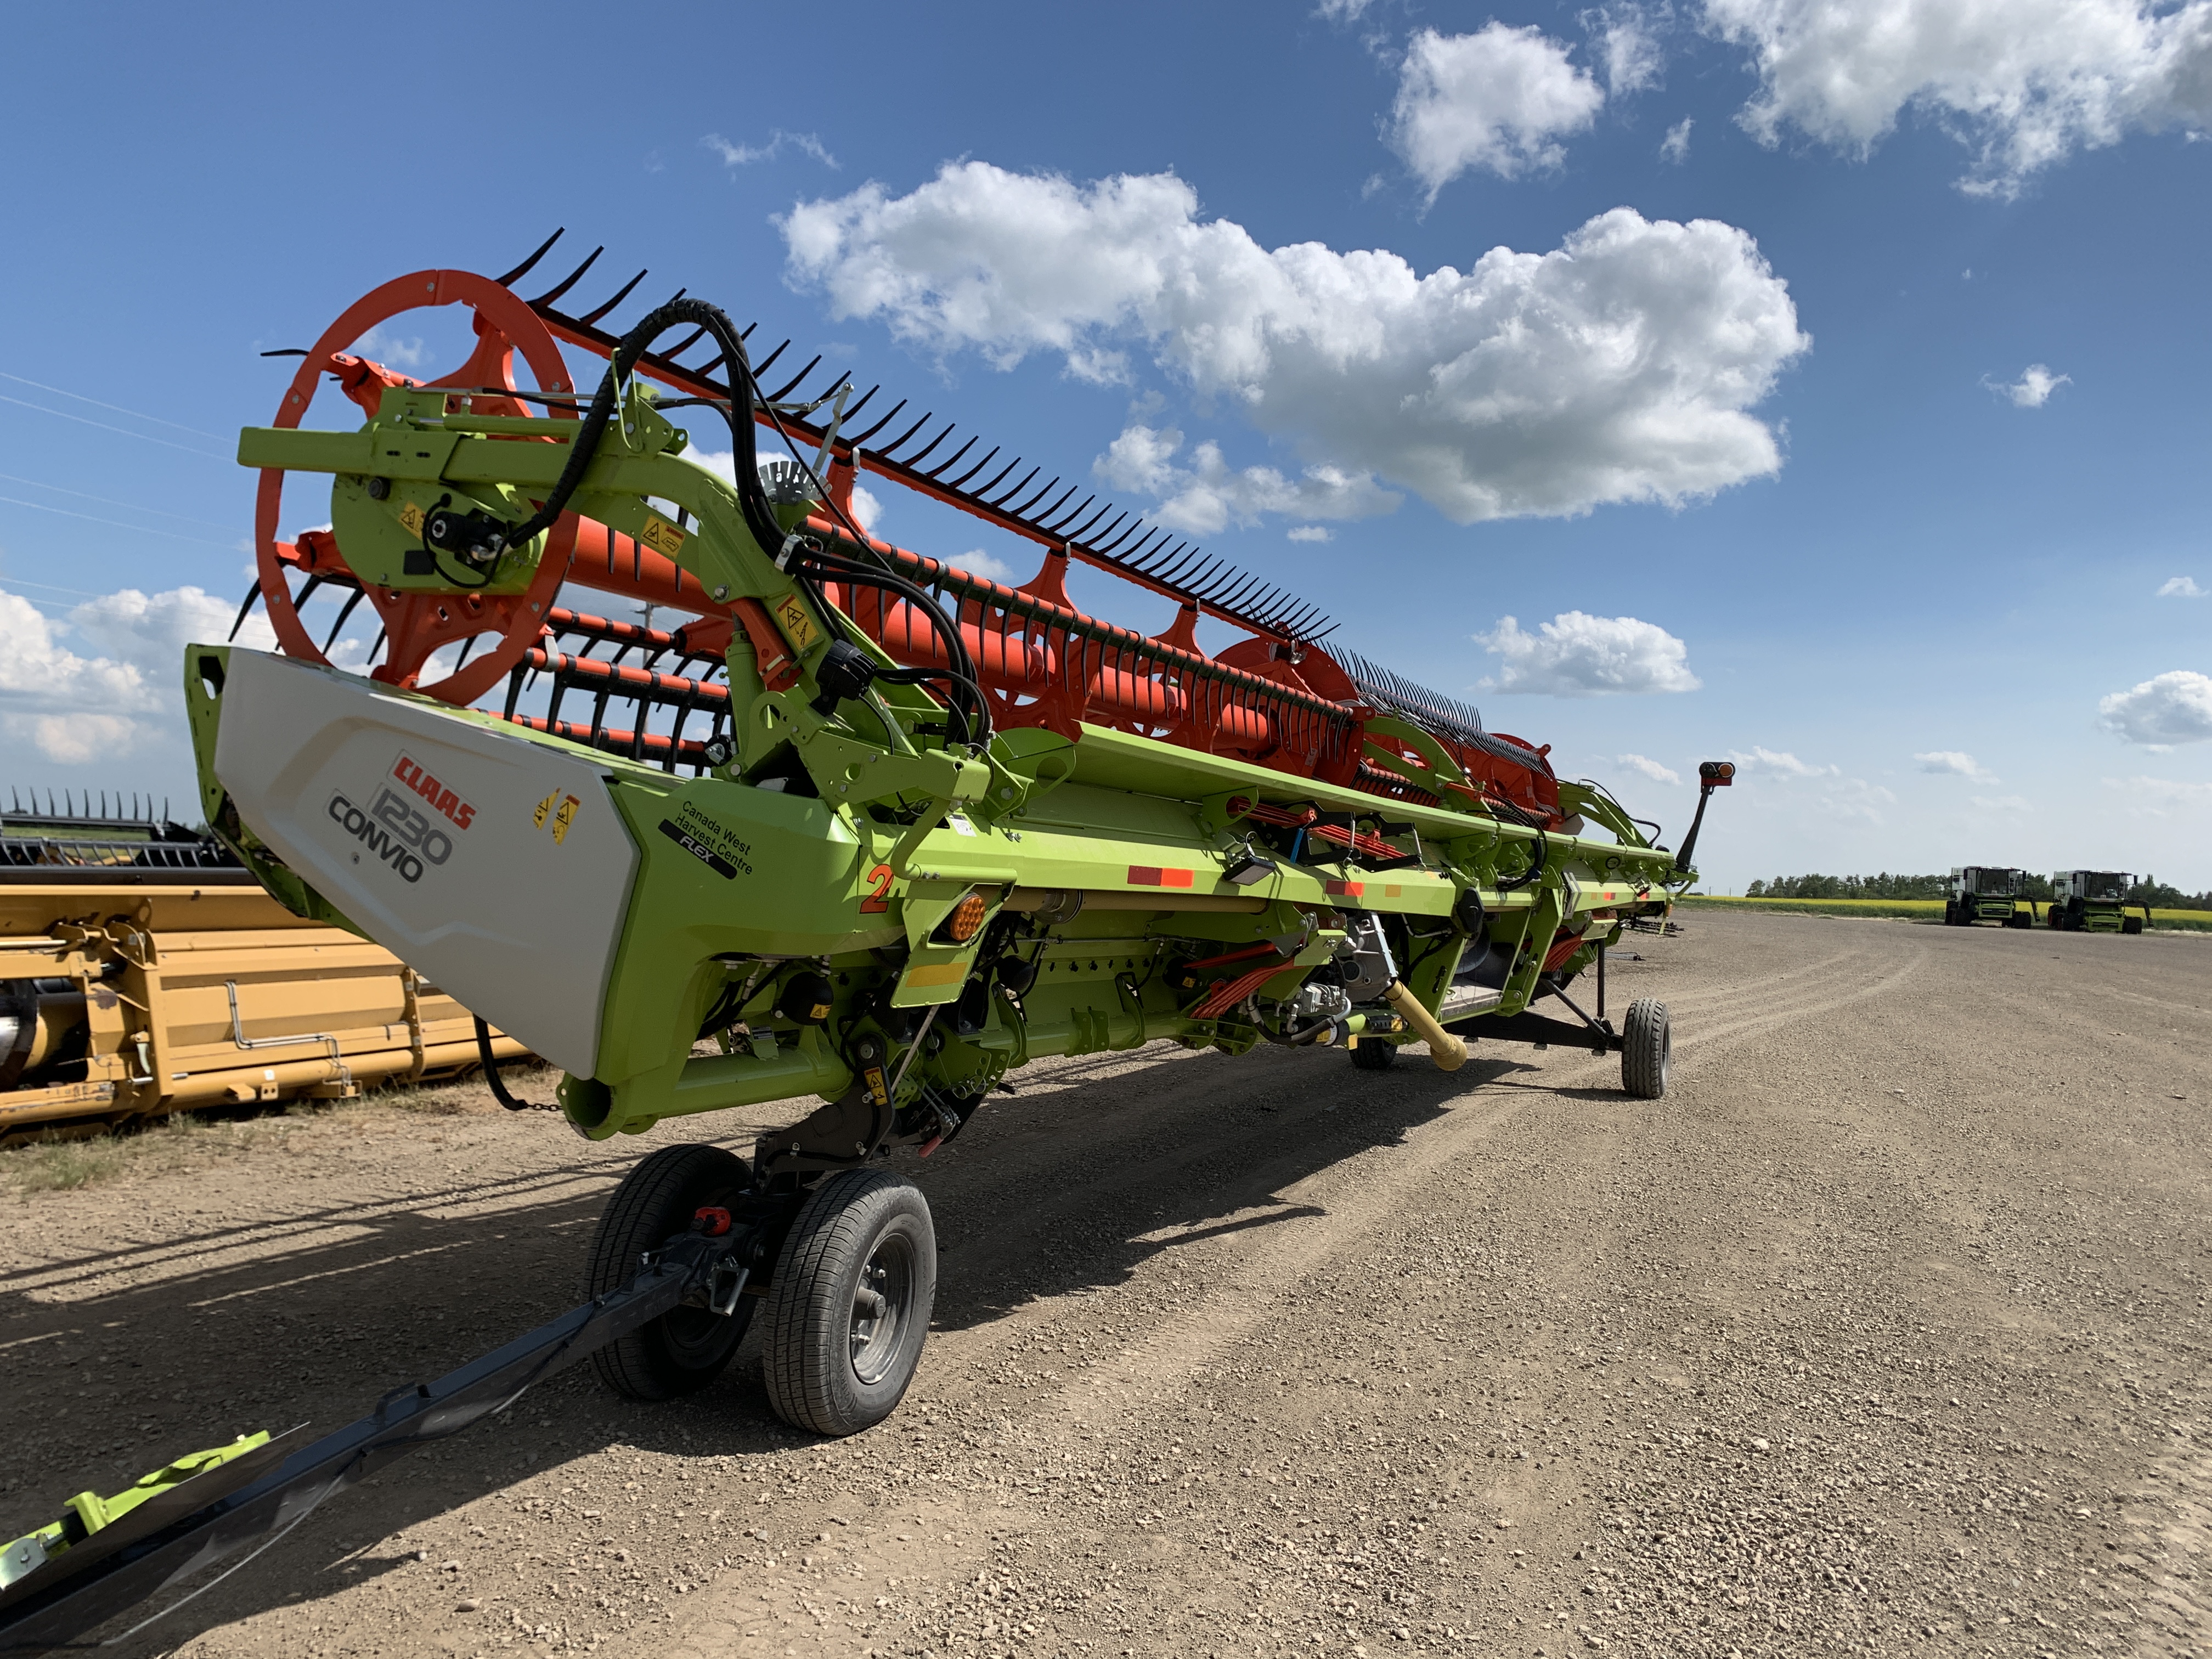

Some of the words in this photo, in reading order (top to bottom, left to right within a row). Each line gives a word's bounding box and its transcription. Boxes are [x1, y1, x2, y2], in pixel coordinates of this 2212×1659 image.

[393, 757, 476, 830] CLAAS
[329, 796, 423, 883] CONVIO
[371, 788, 453, 865] 1230
[675, 812, 715, 849] Harvest
[717, 843, 752, 874] Centre
[679, 836, 714, 862] FLEX
[682, 800, 721, 835] Canada
[723, 828, 751, 856] West
[859, 864, 894, 914] 2
